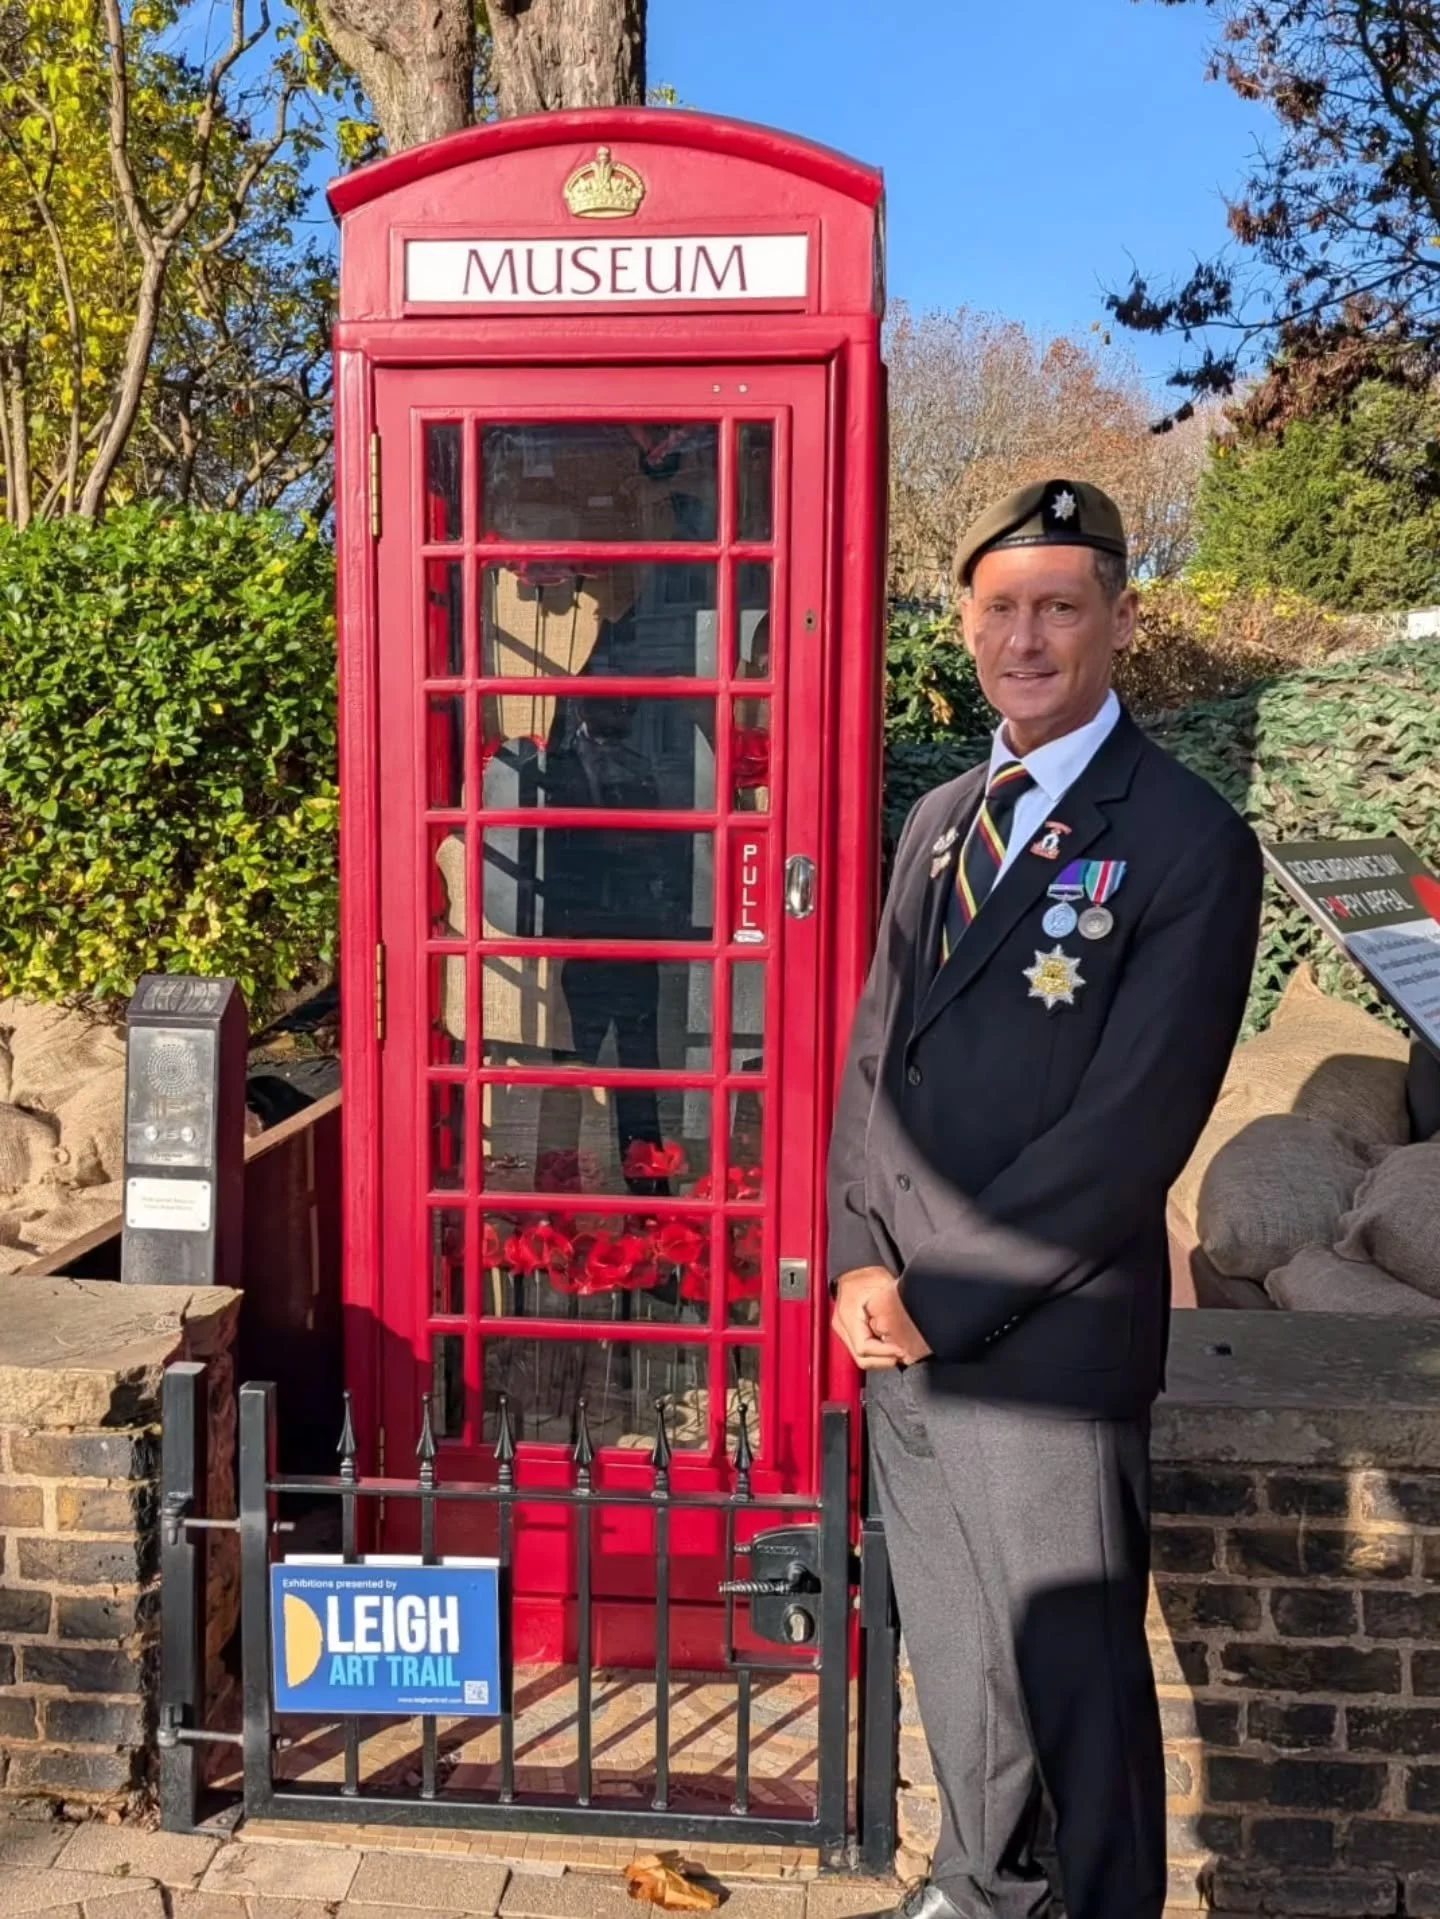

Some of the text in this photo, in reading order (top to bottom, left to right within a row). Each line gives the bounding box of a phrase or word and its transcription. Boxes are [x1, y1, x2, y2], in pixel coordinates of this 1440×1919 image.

[462, 245, 748, 295] MUSEUM
[742, 844, 758, 927] PULL
[282, 1578, 397, 1590] Exhibitions presented by
[327, 1595, 459, 1653] LEIGH
[329, 1655, 460, 1687] ART TRAIL
